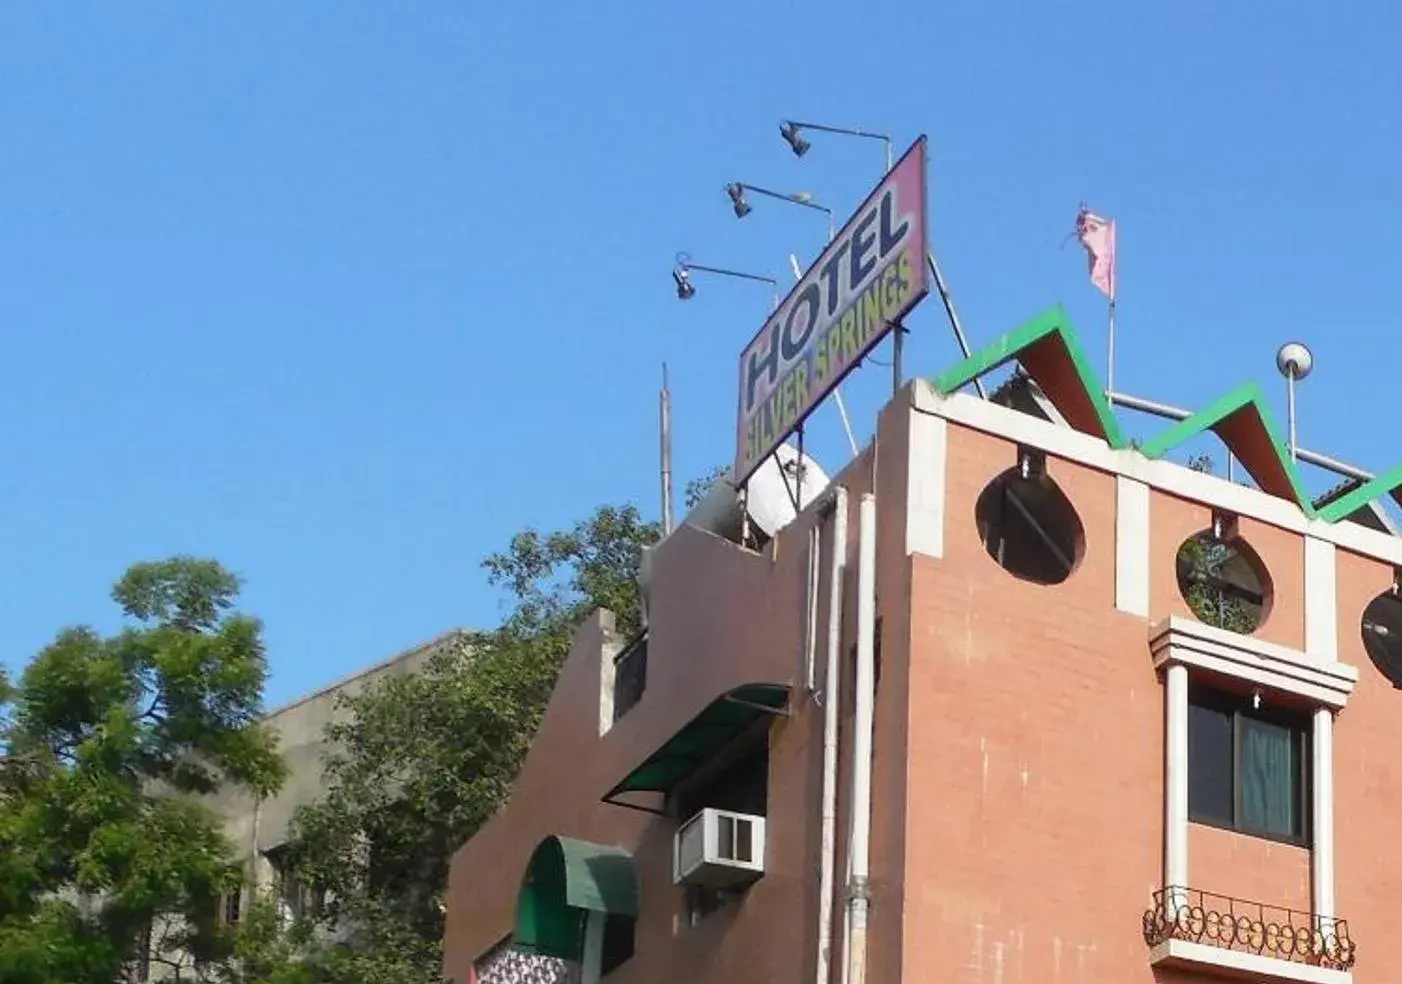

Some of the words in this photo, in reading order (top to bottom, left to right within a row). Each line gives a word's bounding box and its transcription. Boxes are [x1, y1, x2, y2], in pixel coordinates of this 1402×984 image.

[745, 358, 812, 461] SILVER
[817, 250, 912, 380] SPRINGS
[747, 190, 909, 413] HOTEL
